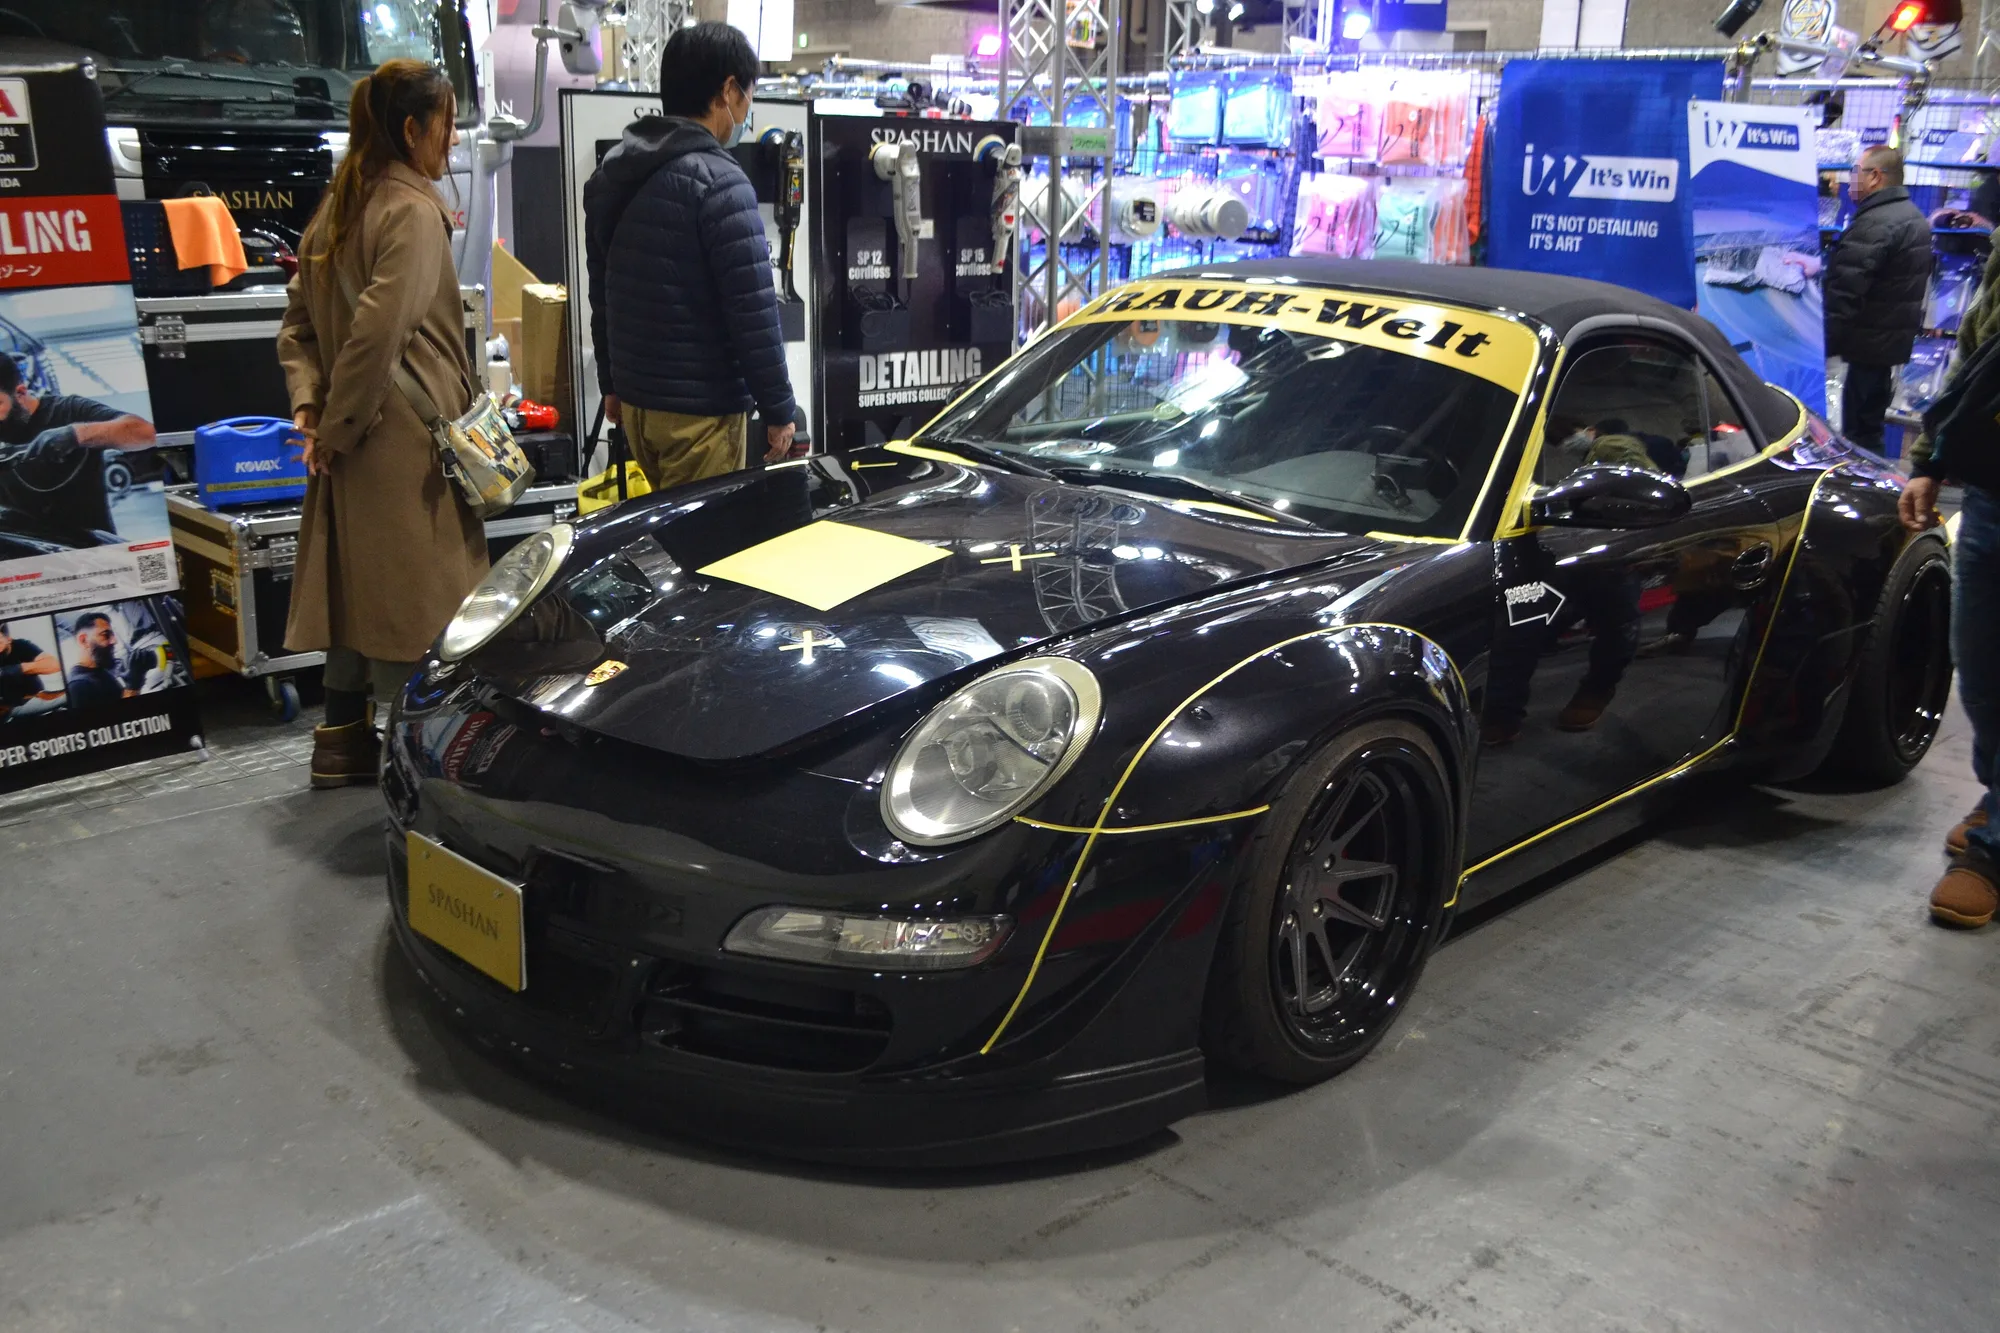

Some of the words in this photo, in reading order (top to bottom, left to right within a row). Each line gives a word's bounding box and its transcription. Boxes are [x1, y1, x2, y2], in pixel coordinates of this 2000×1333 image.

[1769, 128, 1797, 146] Win
[1590, 168, 1623, 187] It's
[1628, 170, 1670, 190] Win
[1531, 213, 1556, 231] IT'S
[1557, 215, 1586, 233] NOT
[1587, 217, 1659, 238] DETAILING
[1529, 233, 1553, 251] IT'S
[1555, 234, 1583, 252] ART
[857, 251, 869, 265] SP
[871, 250, 882, 265] 12
[961, 249, 973, 263] SP
[975, 249, 985, 262] 15
[848, 265, 891, 280] cordless
[1088, 288, 1491, 358] RAUH-Welt
[859, 347, 981, 391] DETAILING
[859, 393, 885, 408] SUPER
[886, 390, 918, 406] SPORTS
[235, 459, 282, 473] KOVAX
[30, 731, 87, 761] SPORTS
[88, 713, 172, 748] COLLECTION
[428, 882, 499, 939] SPASHAN
